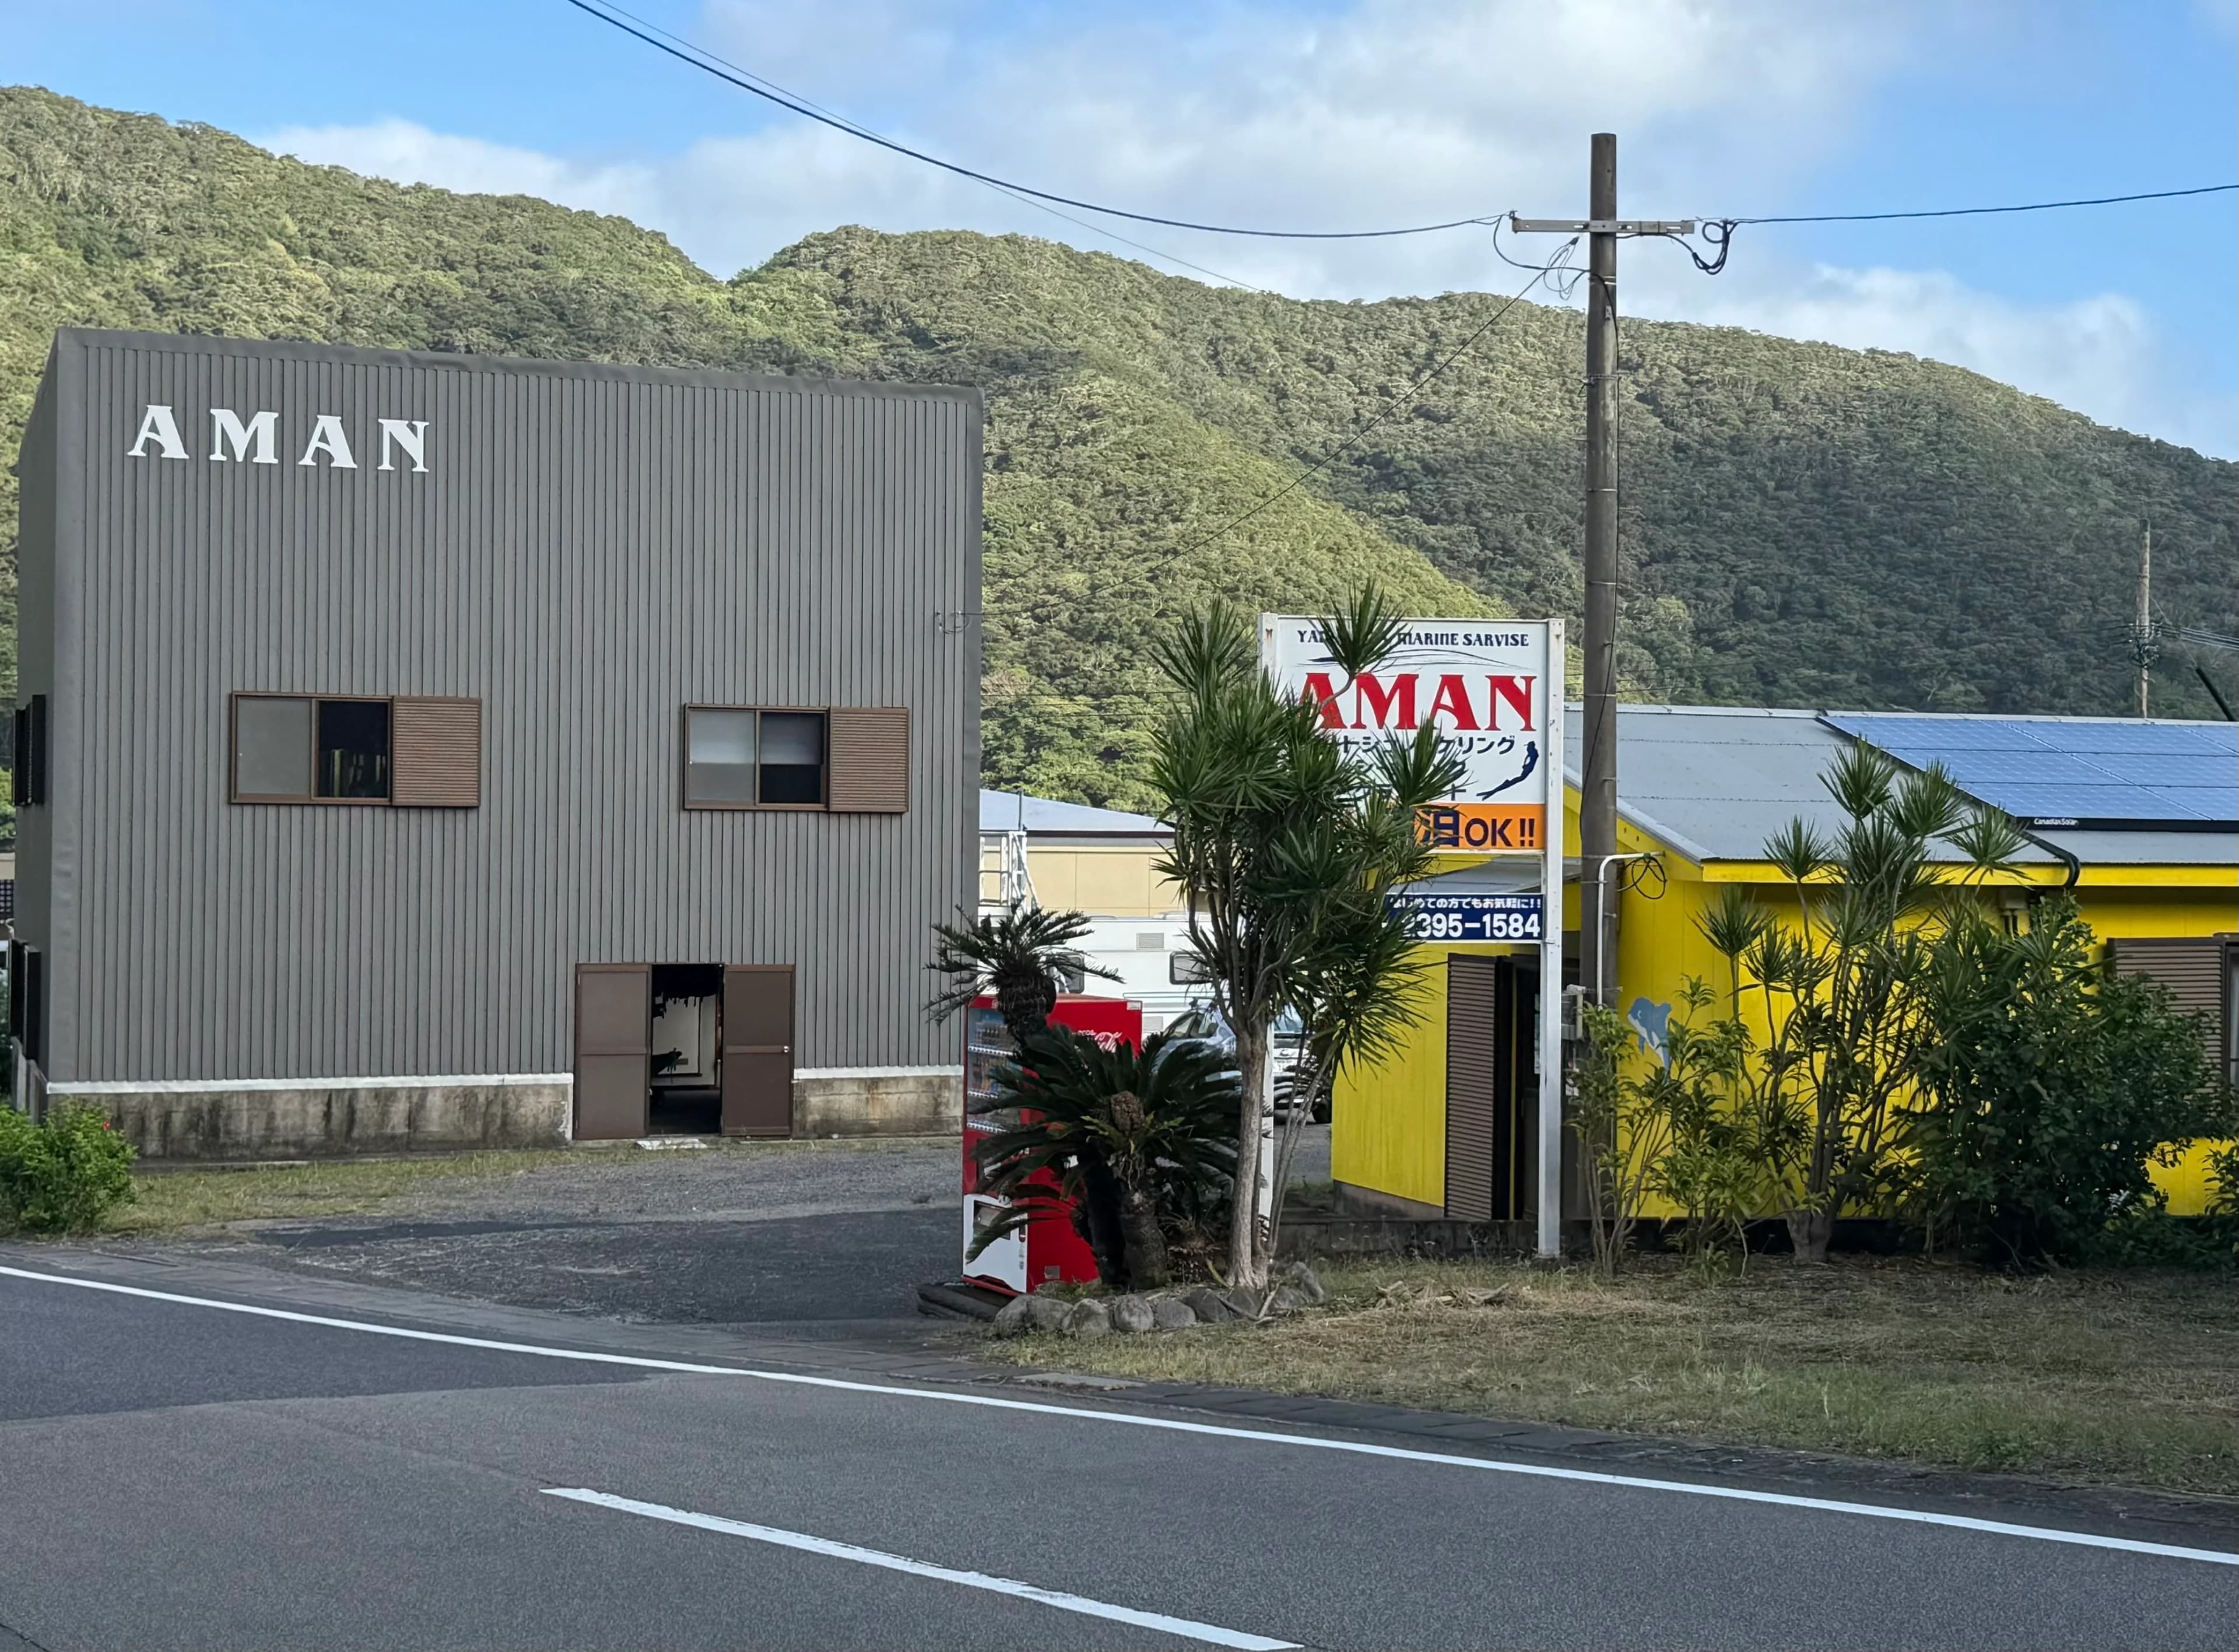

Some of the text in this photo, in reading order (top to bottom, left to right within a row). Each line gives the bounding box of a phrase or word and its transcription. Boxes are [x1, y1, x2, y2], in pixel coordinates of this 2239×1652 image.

[127, 405, 430, 472] AMAN
[1398, 632, 1458, 646] MARINE
[1462, 633, 1529, 646] SARVISE
[1298, 672, 1537, 731] AMAN
